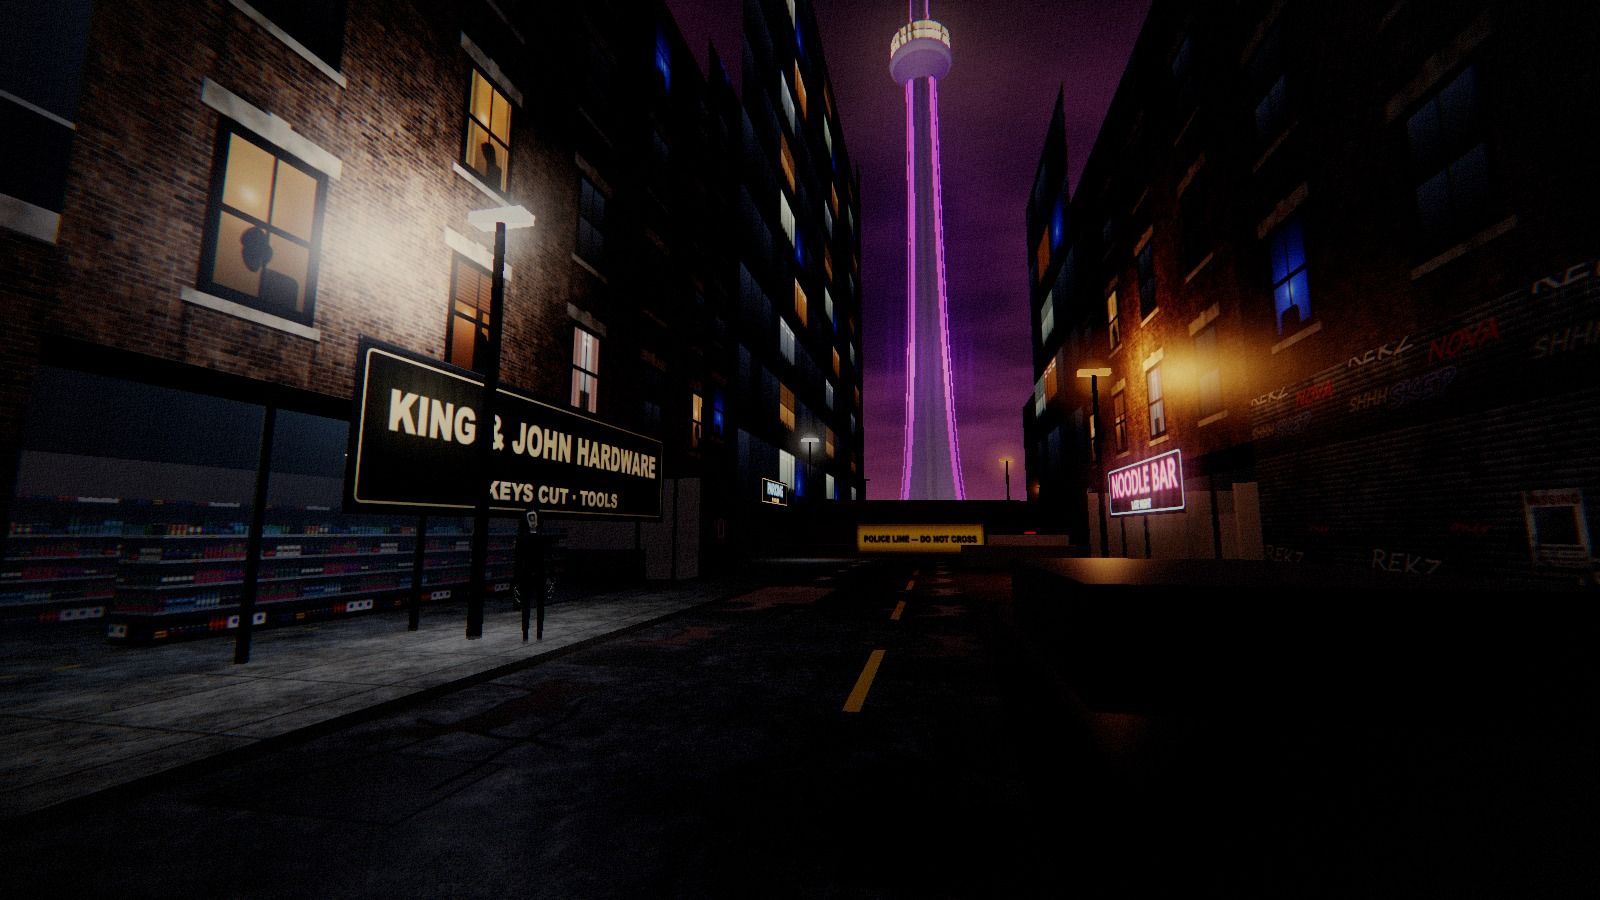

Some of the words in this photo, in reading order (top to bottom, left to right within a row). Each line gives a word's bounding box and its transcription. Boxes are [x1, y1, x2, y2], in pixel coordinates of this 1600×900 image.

[1424, 316, 1502, 364] NOVA
[388, 388, 477, 446] KING
[493, 413, 505, 451] &
[512, 422, 572, 464] JOHN
[577, 437, 656, 479] HARDWARE
[489, 480, 534, 503] KEYS
[538, 485, 569, 505] CUT
[579, 490, 618, 509] TOOLS
[1111, 465, 1150, 499] NOODLE
[1151, 456, 1178, 492] BAR
[863, 535, 891, 544] POLICE
[920, 535, 931, 544] DO
[933, 535, 949, 544] NOT
[952, 535, 978, 544] CROSS
